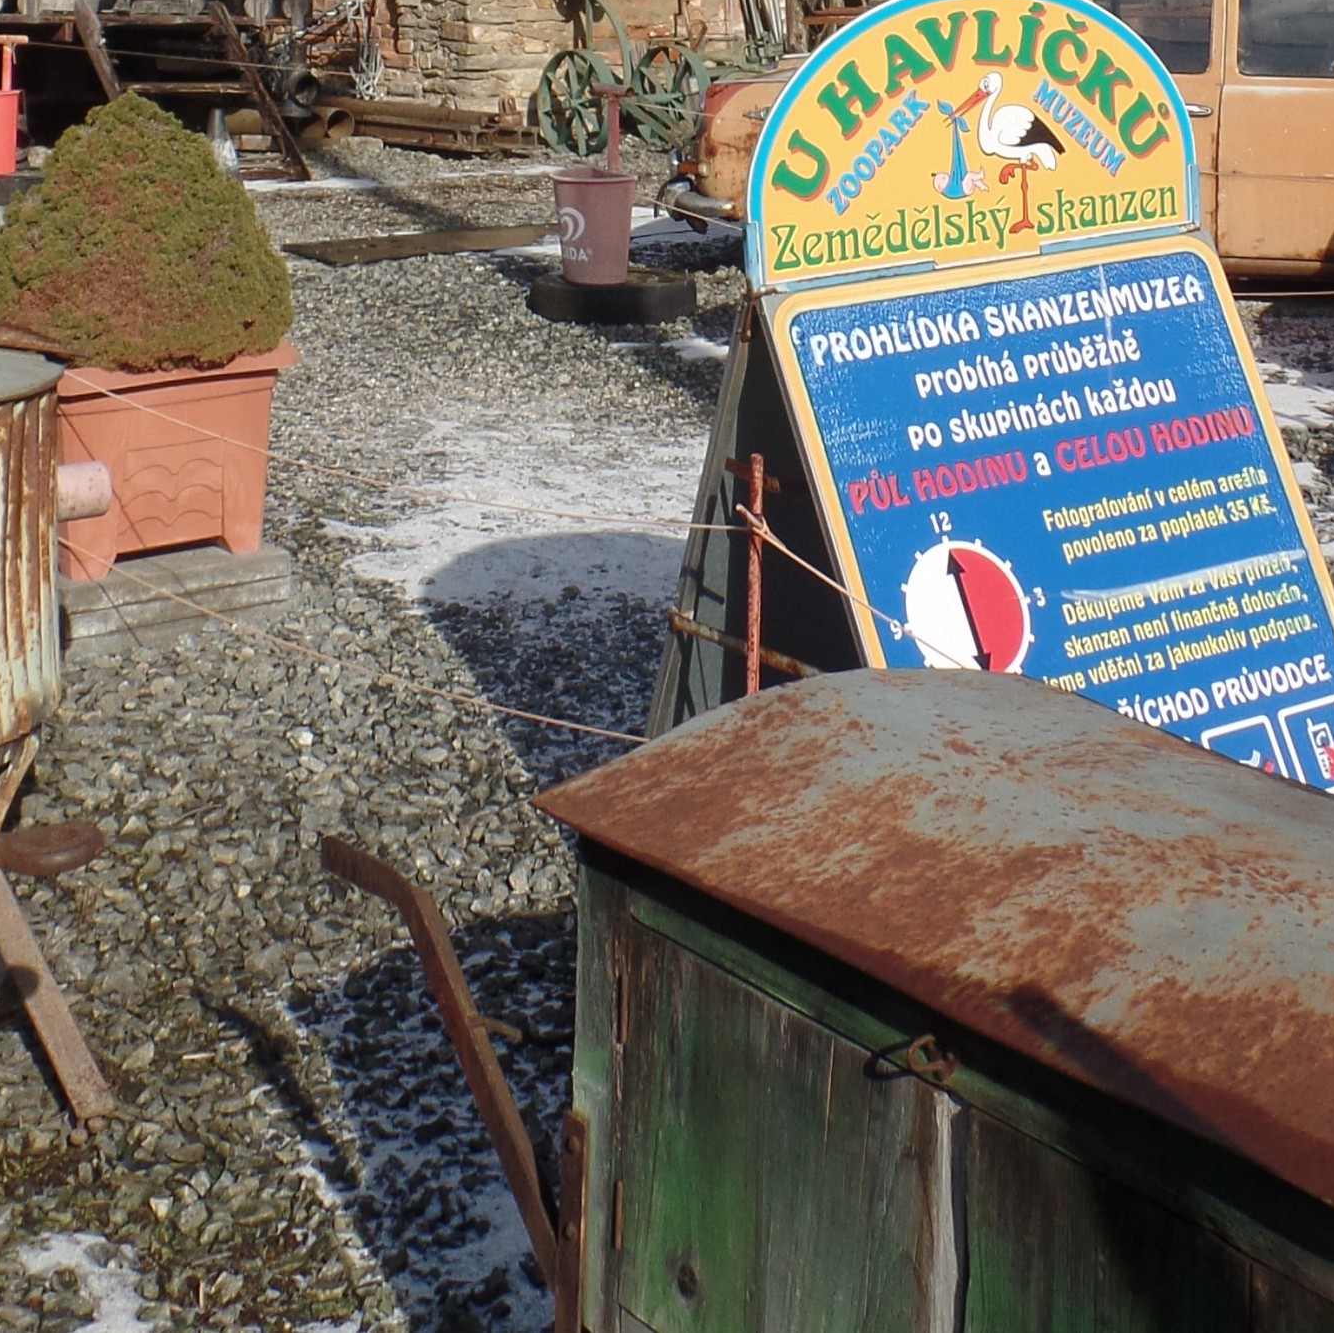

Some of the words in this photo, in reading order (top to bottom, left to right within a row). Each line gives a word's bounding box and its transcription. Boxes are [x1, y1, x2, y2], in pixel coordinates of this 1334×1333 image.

[771, 130, 829, 203] U
[817, 1, 1171, 159] HAVLÍČKŮ
[1032, 78, 1127, 177] MUZEUM
[825, 88, 931, 216] ZOOPARK
[772, 195, 1011, 272] Zemědělský
[1037, 184, 1178, 236] skanzen
[809, 310, 980, 367] PROHLÍDKA
[983, 273, 1205, 338] SKANZENMUZEA
[915, 348, 1017, 399] probíhá
[1022, 328, 1141, 380] průběžně
[907, 420, 943, 451] po
[949, 390, 1082, 444] skupinách
[1085, 376, 1177, 421] každou
[848, 470, 910, 516] PŮL
[913, 450, 1028, 501] HODINU
[1033, 451, 1053, 476] a
[1054, 426, 1146, 473] CELOU
[1149, 405, 1255, 453] HODINU
[929, 511, 953, 534] 12
[1042, 486, 1153, 532] Fotografování
[1154, 489, 1166, 507] v
[1168, 477, 1217, 505] celém
[1062, 526, 1137, 564] povoleno
[1137, 523, 1159, 543] za
[1160, 503, 1228, 542] poplatek
[1227, 499, 1250, 522] 35
[889, 618, 904, 641] 9
[1032, 586, 1047, 608] 3
[1061, 590, 1146, 626] Děkujeme
[1146, 581, 1187, 605] Vám
[1187, 576, 1206, 596] za
[1064, 626, 1131, 659] skanzen
[1134, 615, 1169, 643] není
[1171, 595, 1240, 633] finančně
[1087, 650, 1144, 685] vděční
[1144, 652, 1166, 671] za
[1166, 628, 1248, 671] jakoukoliv
[1116, 687, 1209, 728] ŘÍCHOD
[1211, 652, 1333, 711] PRŮVODCE
